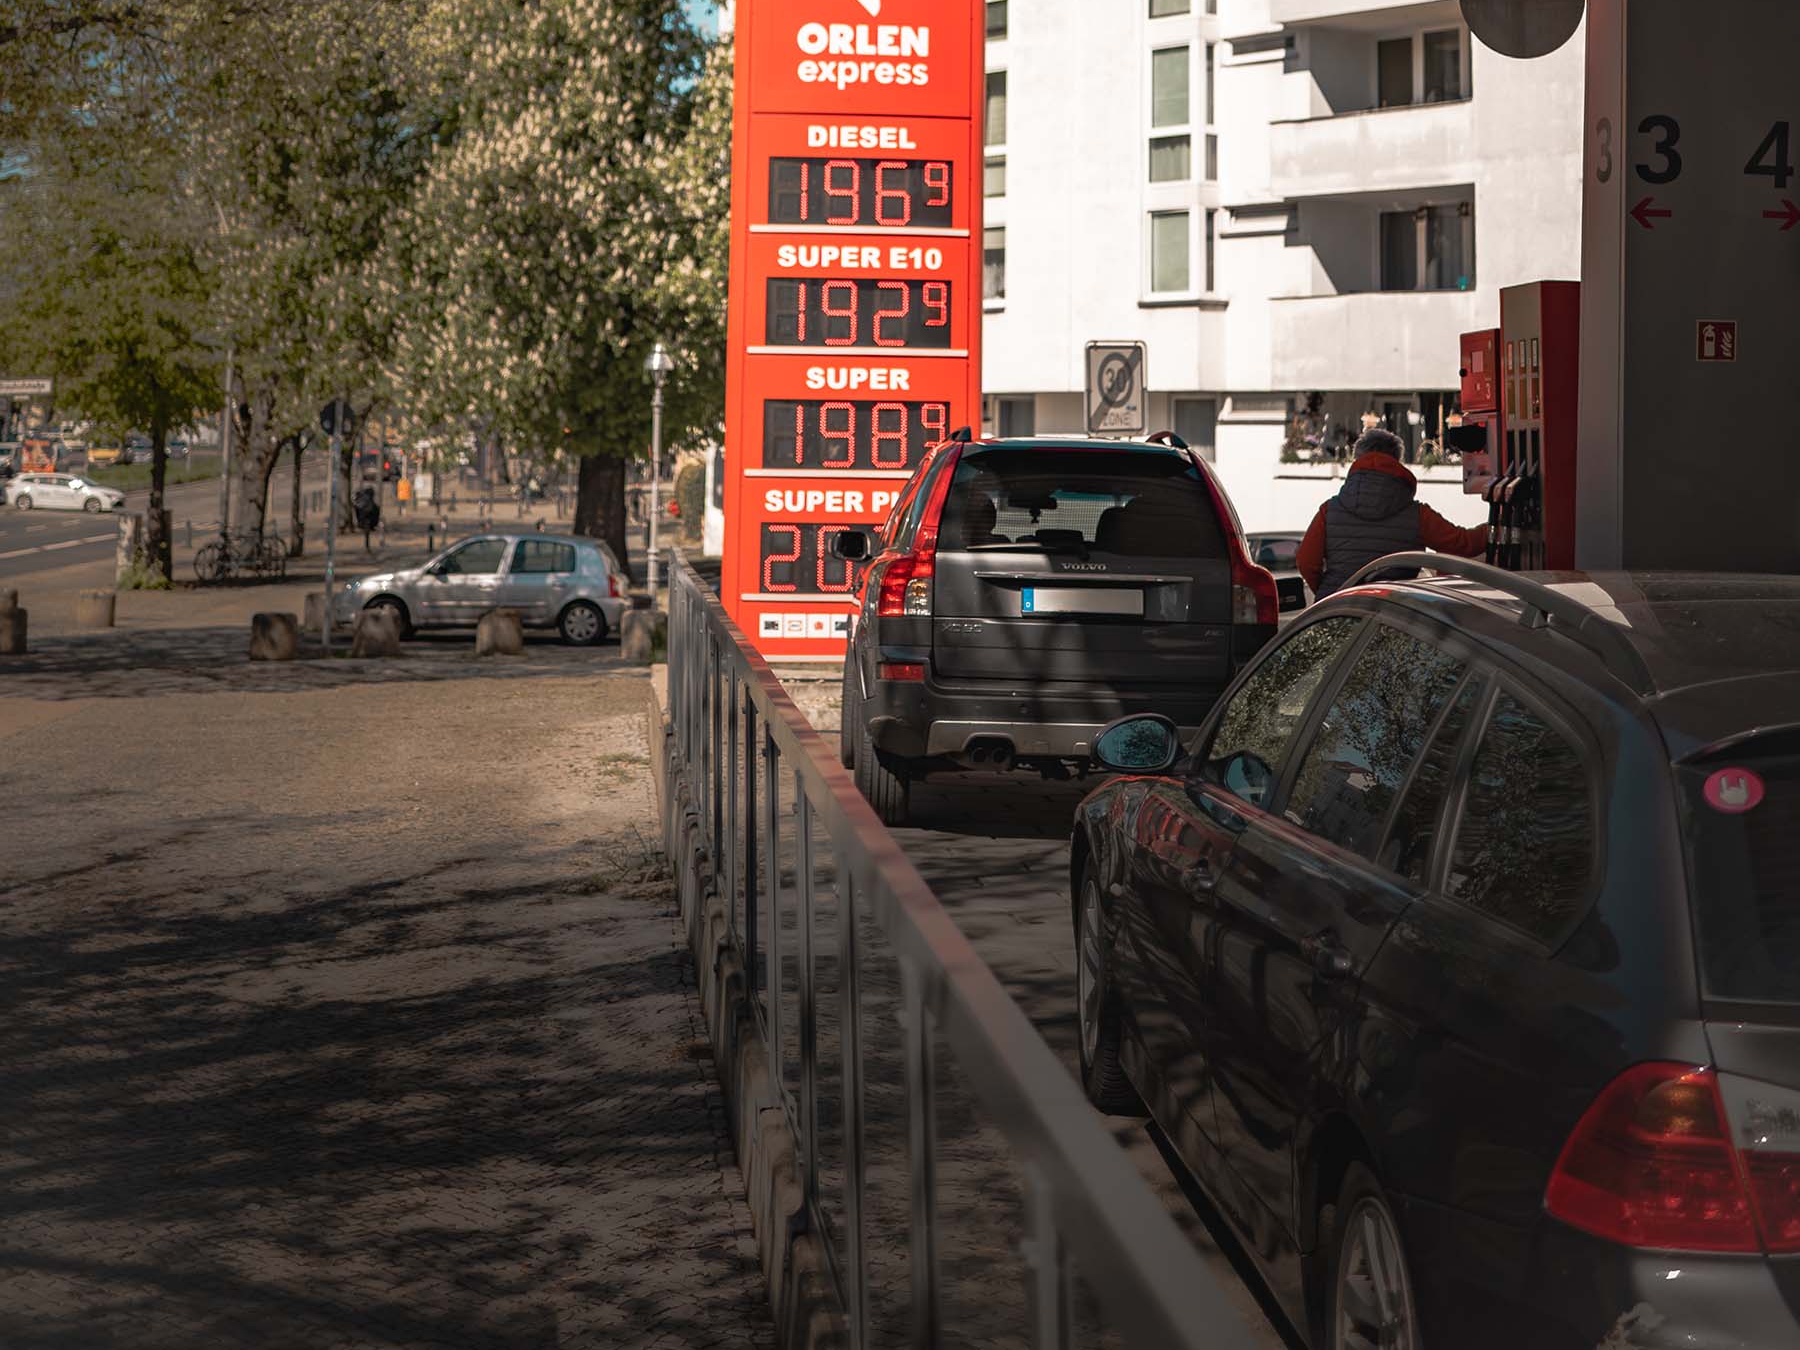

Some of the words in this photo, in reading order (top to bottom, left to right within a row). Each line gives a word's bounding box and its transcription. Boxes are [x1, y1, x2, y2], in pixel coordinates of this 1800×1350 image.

[797, 22, 929, 57] ORLEN
[797, 59, 929, 90] express
[807, 125, 917, 150] DIESEL
[1595, 116, 1612, 184] 3
[1635, 114, 1682, 185] 3
[1743, 121, 1795, 189] 4
[777, 244, 881, 269] SUPER
[889, 246, 943, 270] E10
[805, 366, 911, 391] SUPER
[1105, 367, 1128, 392] 30
[1103, 411, 1133, 427] ZONE
[764, 489, 865, 513] SUPER
[1061, 562, 1108, 571] VOLVO
